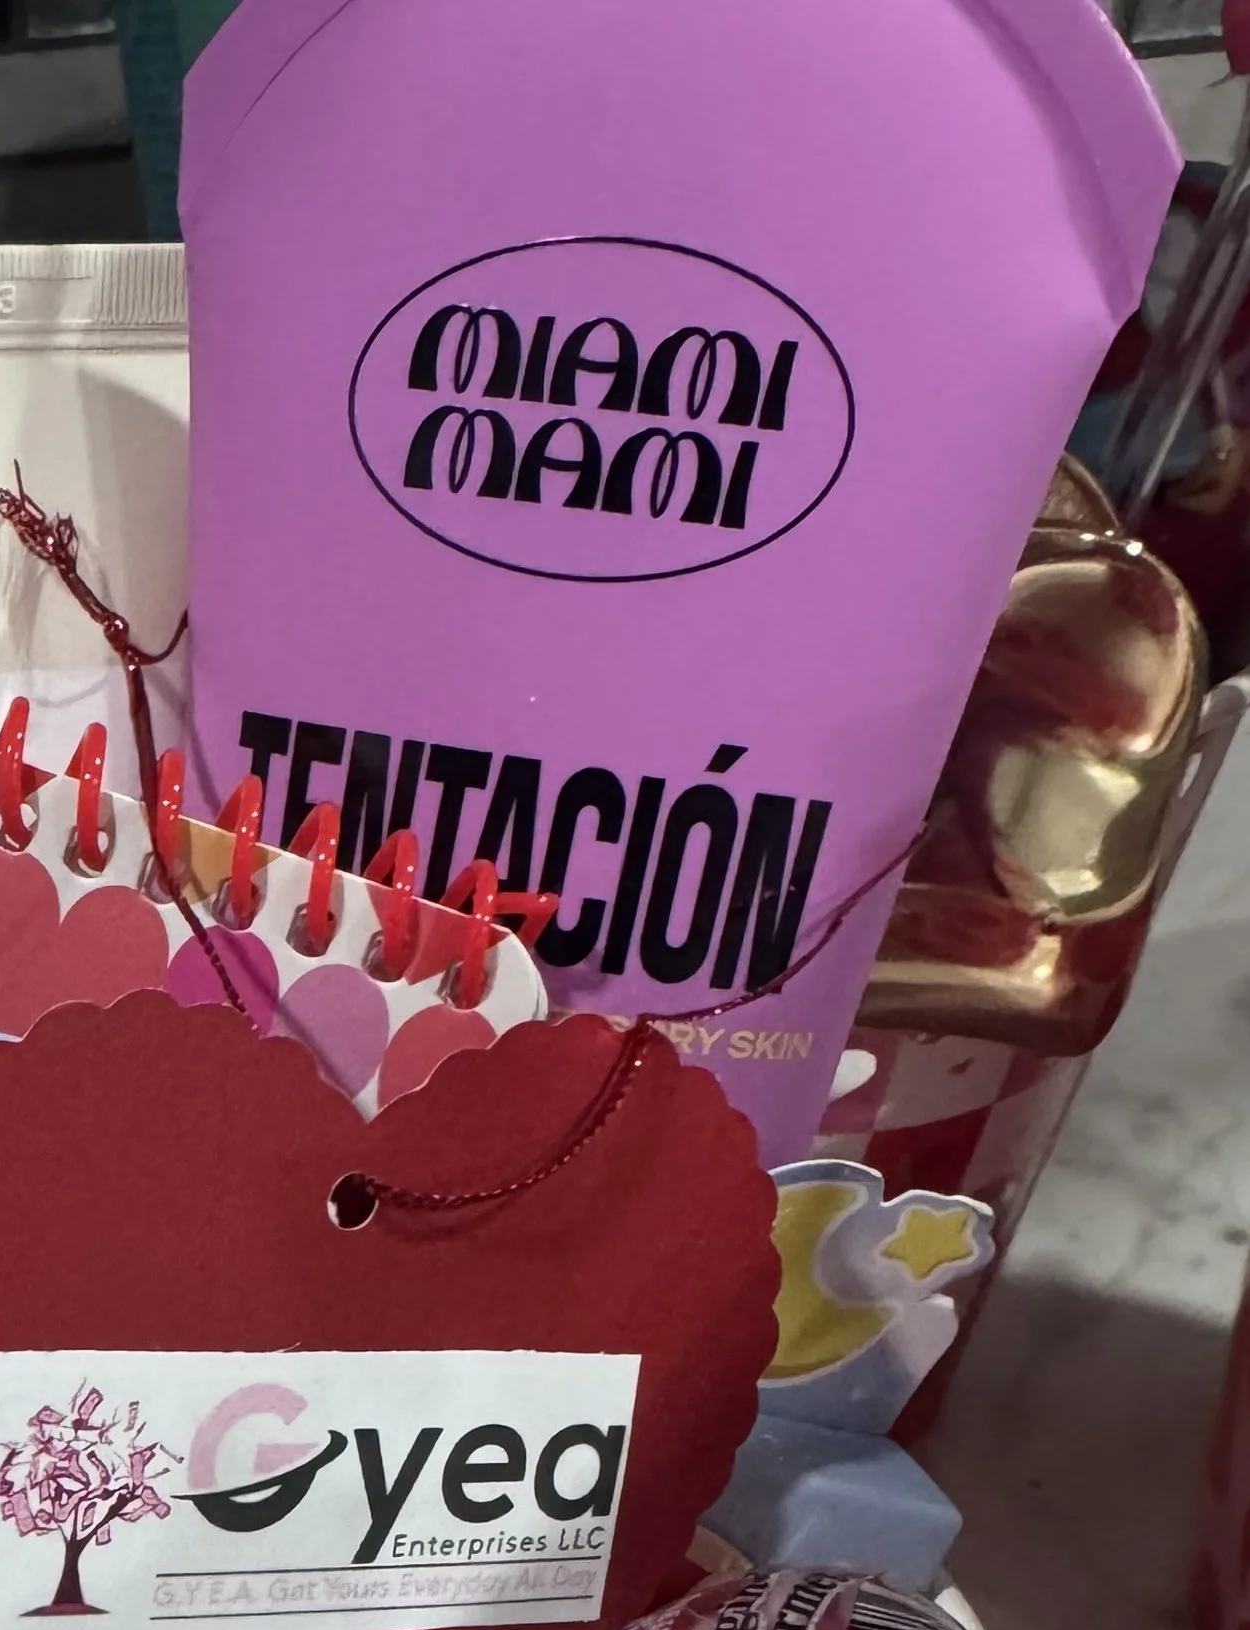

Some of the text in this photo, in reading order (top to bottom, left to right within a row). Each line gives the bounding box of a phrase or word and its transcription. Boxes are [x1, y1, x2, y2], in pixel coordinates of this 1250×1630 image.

[407, 303, 799, 432] MIAMI
[402, 404, 760, 530] MAMI
[237, 709, 833, 994] TENTACIÓN
[726, 1029, 813, 1061] SKIN
[171, 1382, 626, 1564] Gyea
[392, 1526, 606, 1560] Enterprises LLC
